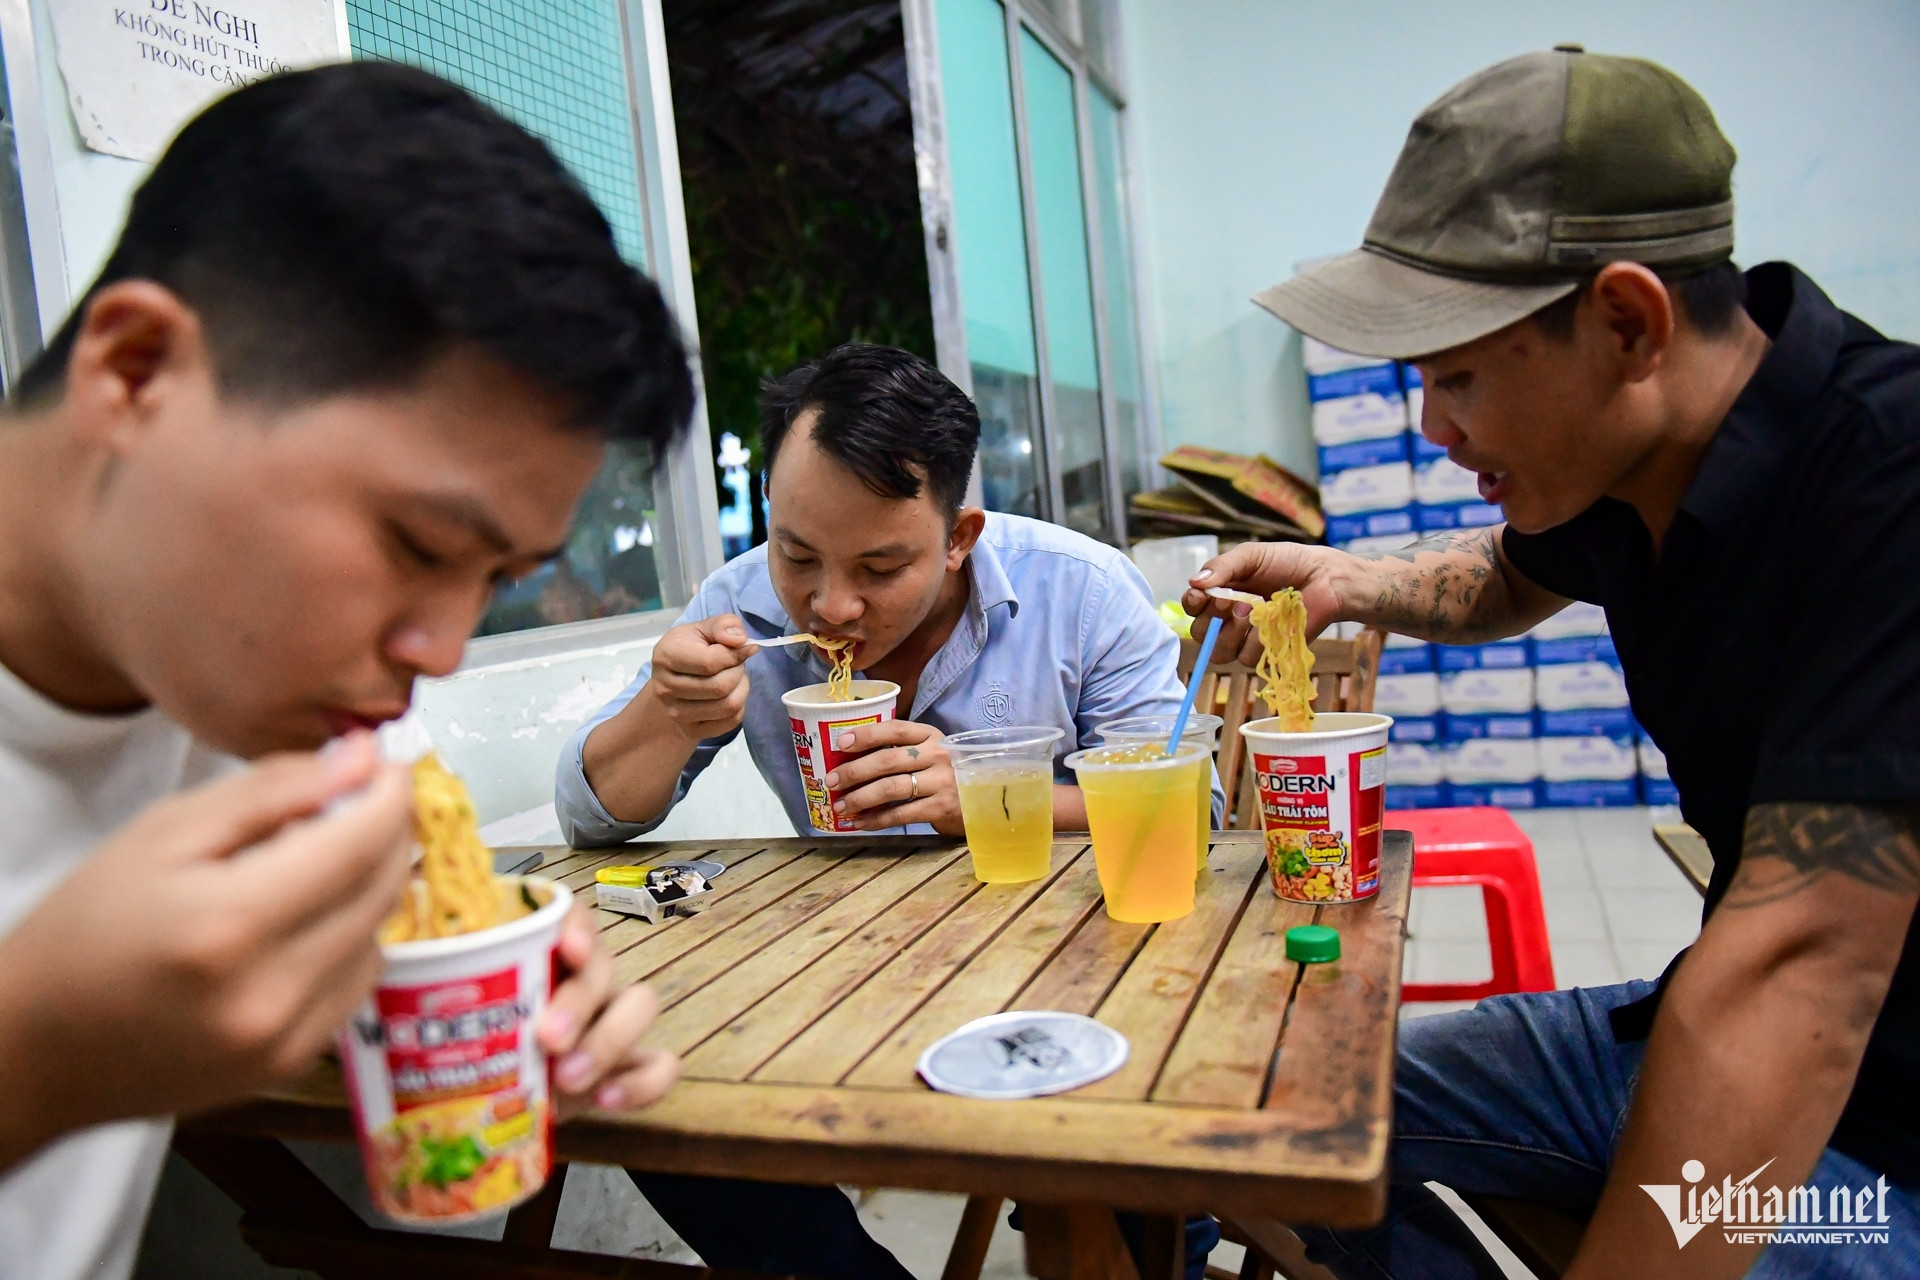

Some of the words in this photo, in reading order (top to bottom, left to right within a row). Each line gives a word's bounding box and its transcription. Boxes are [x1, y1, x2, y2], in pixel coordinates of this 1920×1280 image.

[115, 8, 187, 46] KHÔNG
[193, 34, 229, 60] HÚT
[192, 1, 260, 49] NGHỊ
[137, 41, 205, 77] TRONG
[1303, 804, 1328, 818] TÔM
